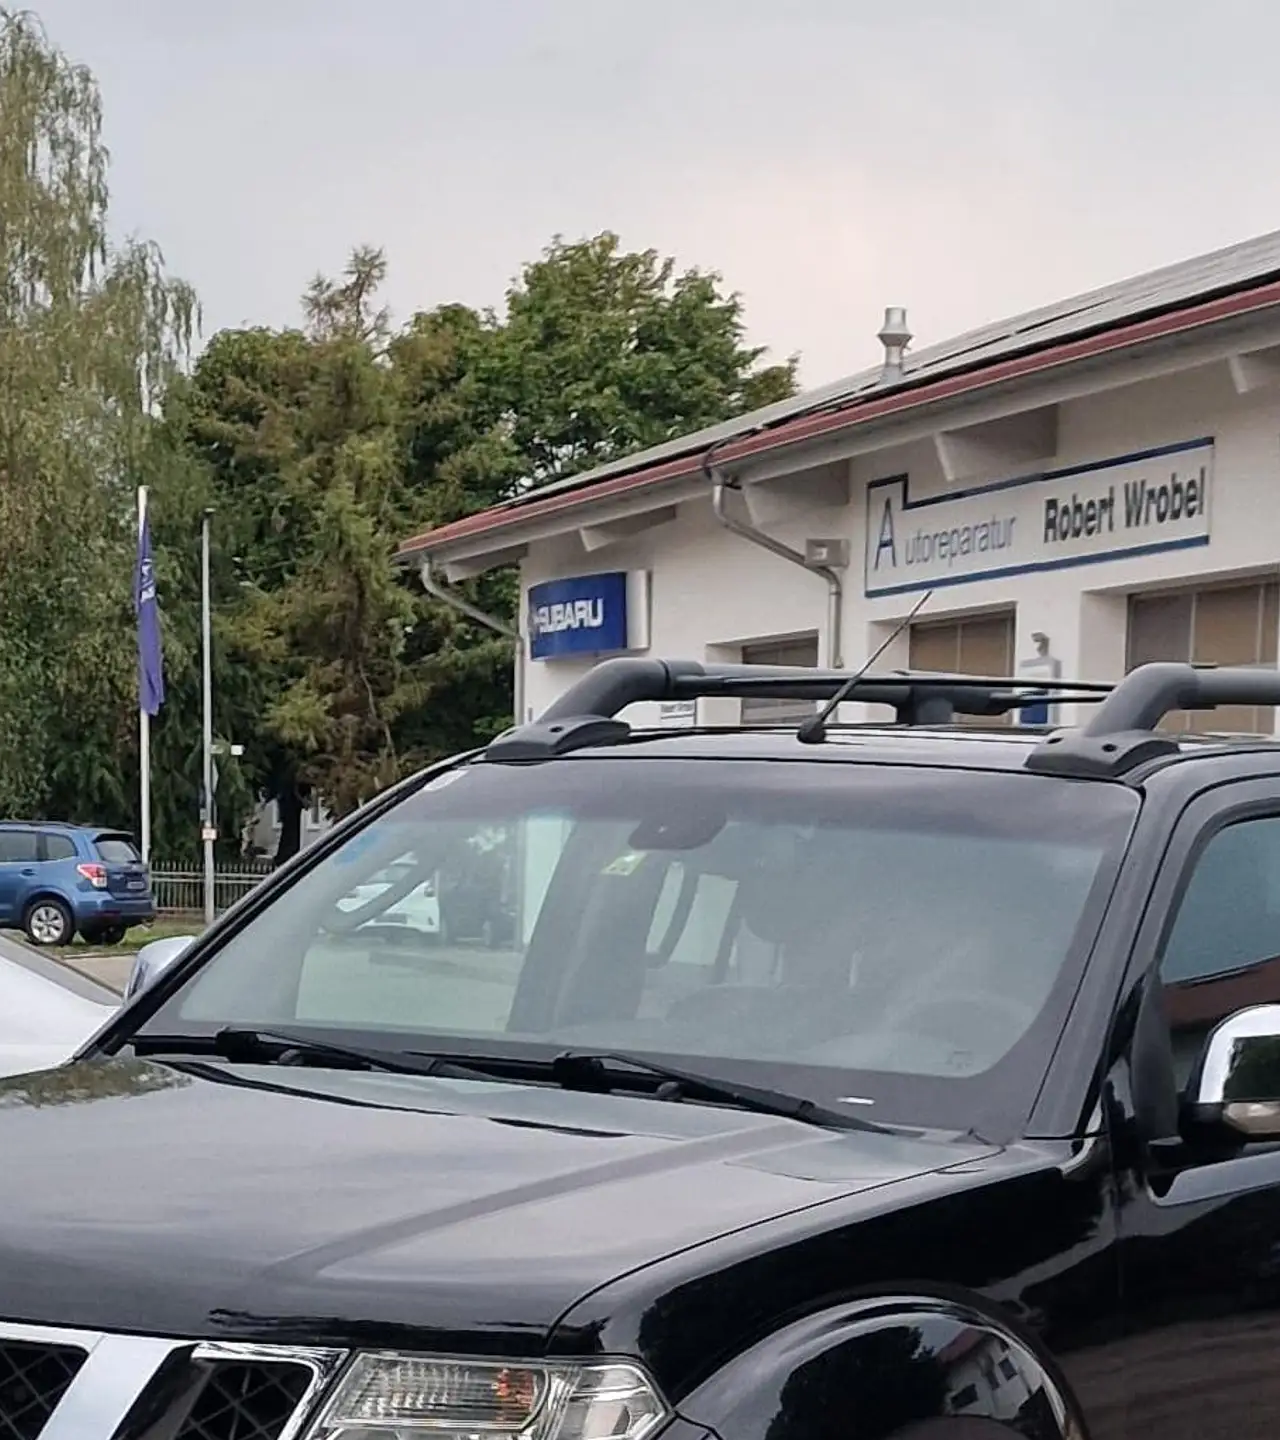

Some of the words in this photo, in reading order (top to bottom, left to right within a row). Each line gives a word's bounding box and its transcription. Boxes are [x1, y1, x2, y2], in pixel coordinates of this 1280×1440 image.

[1044, 485, 1115, 544] Robert
[1124, 465, 1206, 529] Wrobel
[536, 597, 605, 634] SUBARU
